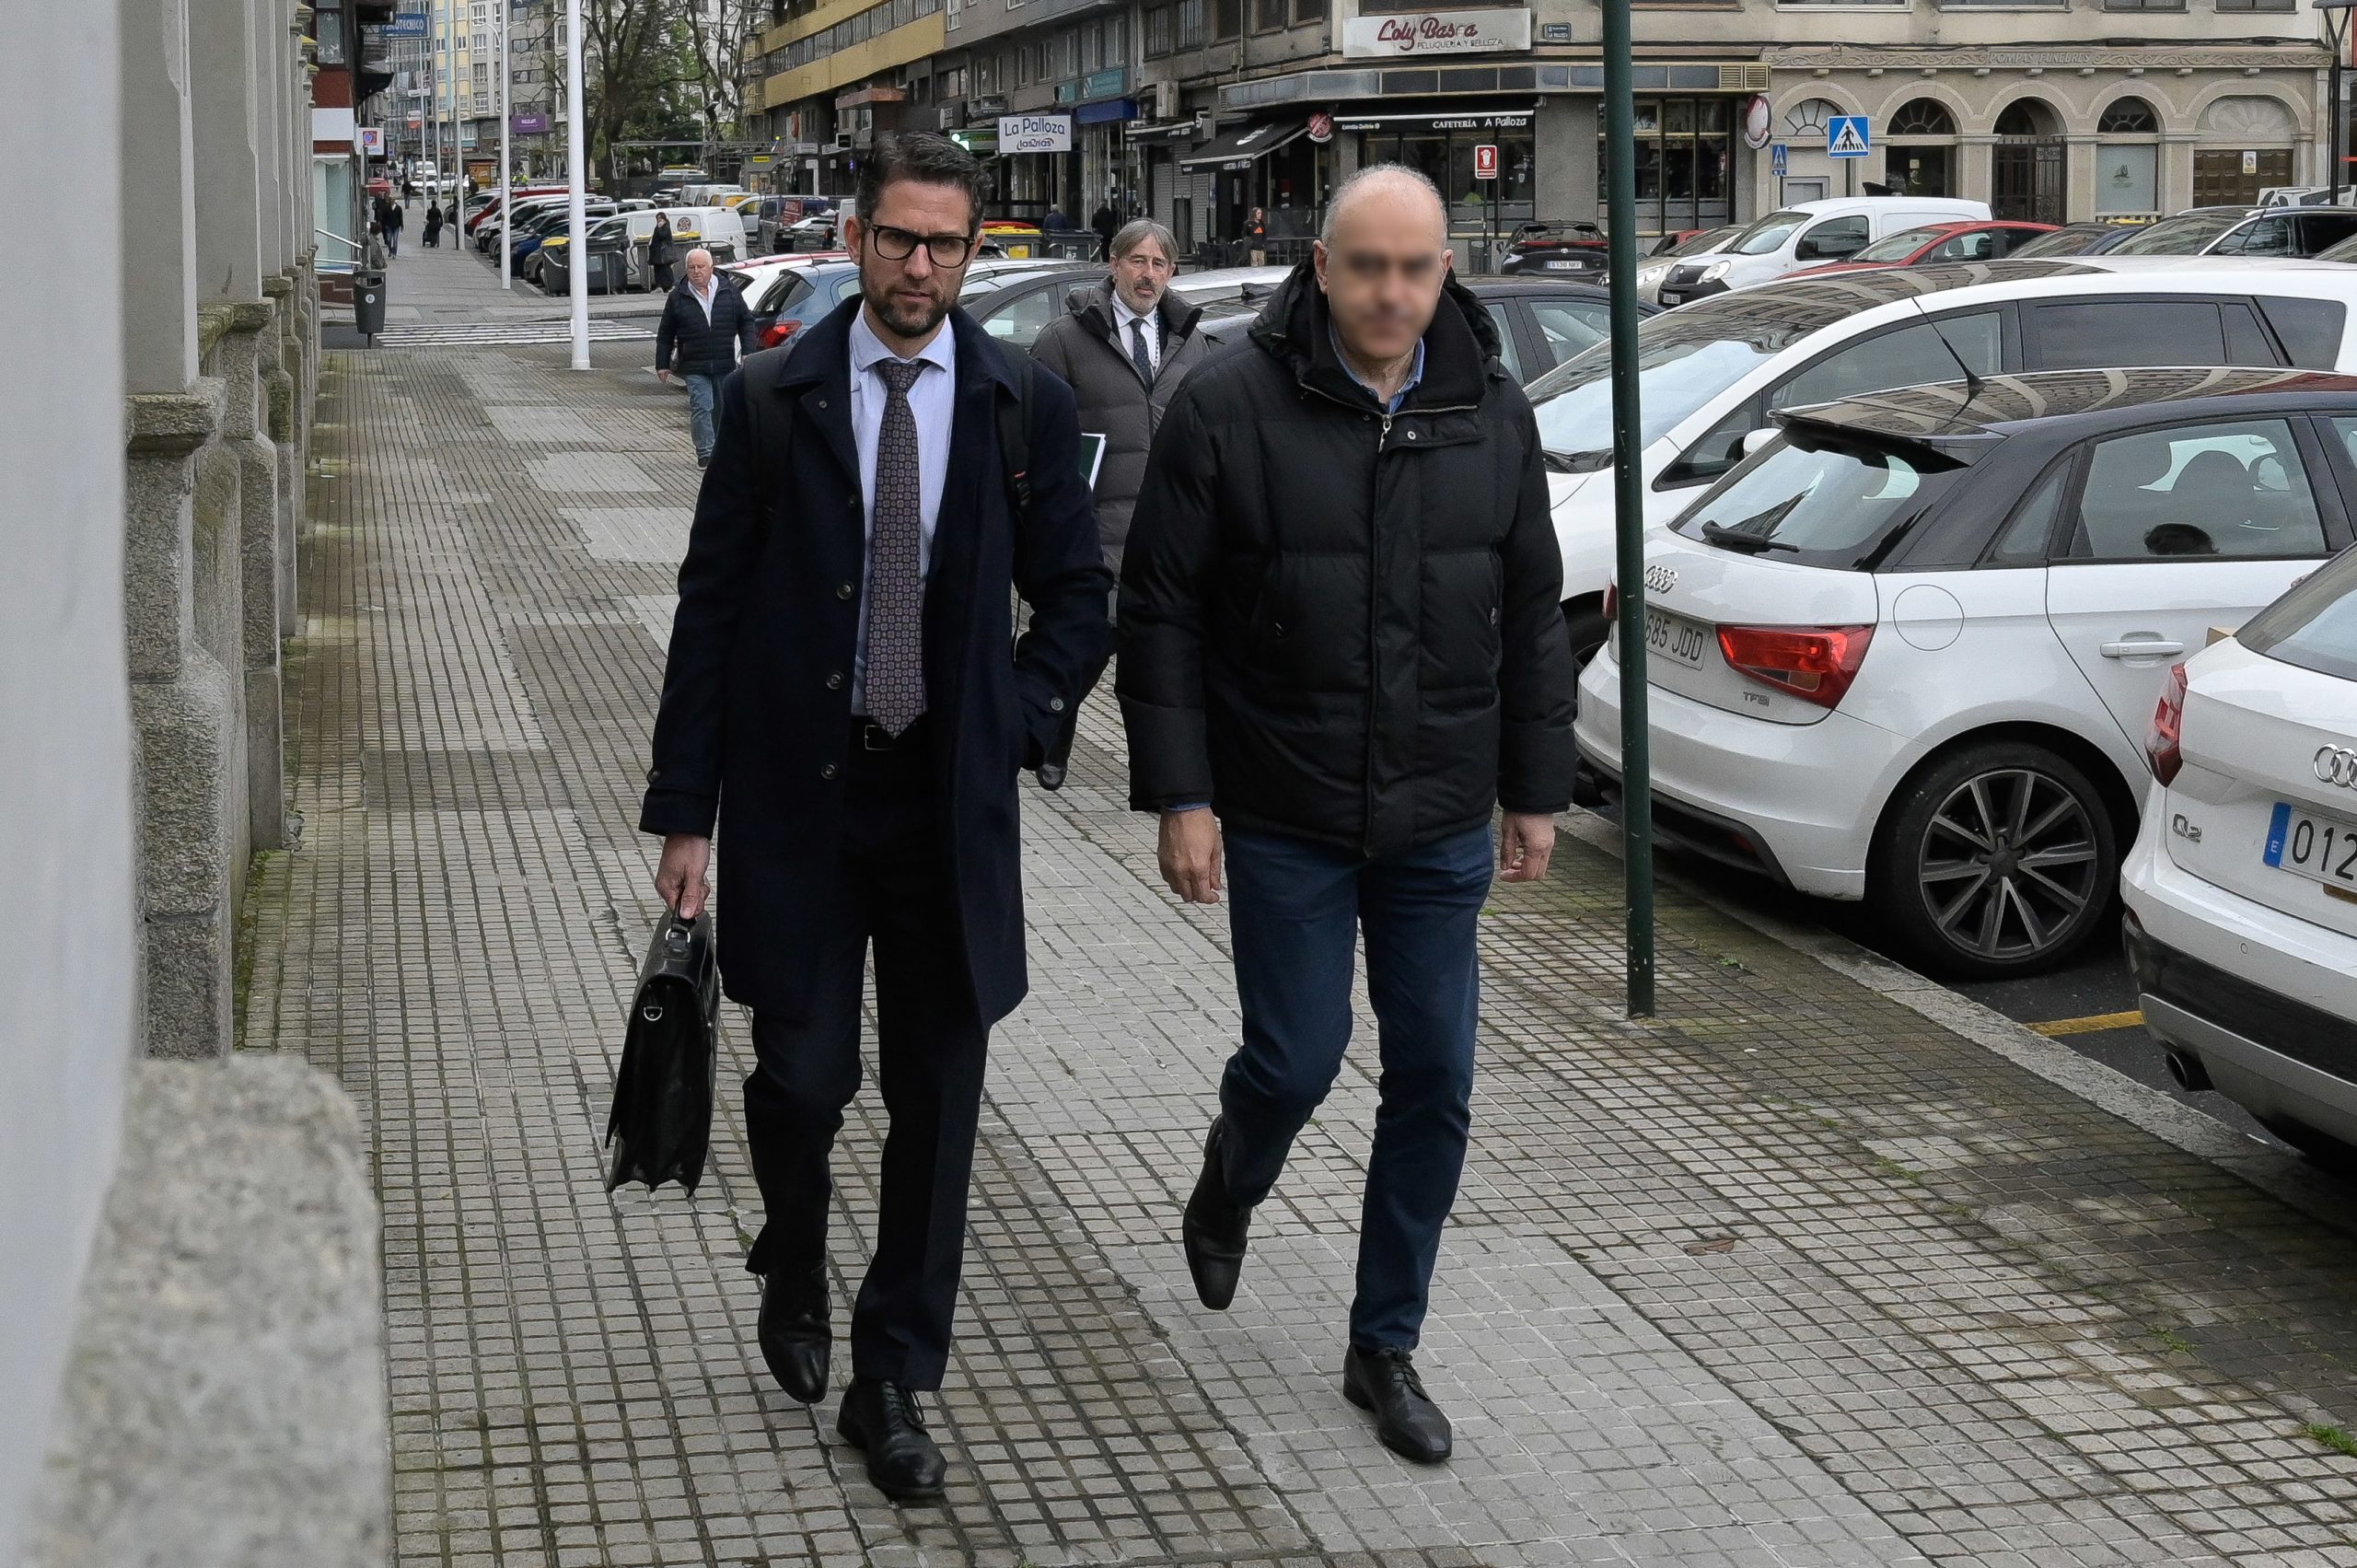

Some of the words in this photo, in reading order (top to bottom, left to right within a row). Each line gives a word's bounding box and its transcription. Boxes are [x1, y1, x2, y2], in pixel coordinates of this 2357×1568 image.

[1470, 38, 1504, 47] BELLEZA
[1004, 122, 1019, 136] La
[1023, 118, 1065, 135] Palloza
[1433, 119, 1477, 129] CAFETERÍA
[1484, 118, 1492, 127] A
[1495, 117, 1527, 127] Palloza
[1672, 626, 1703, 662] JDD
[1743, 691, 1770, 707] TFSI
[2172, 813, 2202, 843] Q2
[2270, 840, 2280, 854] E
